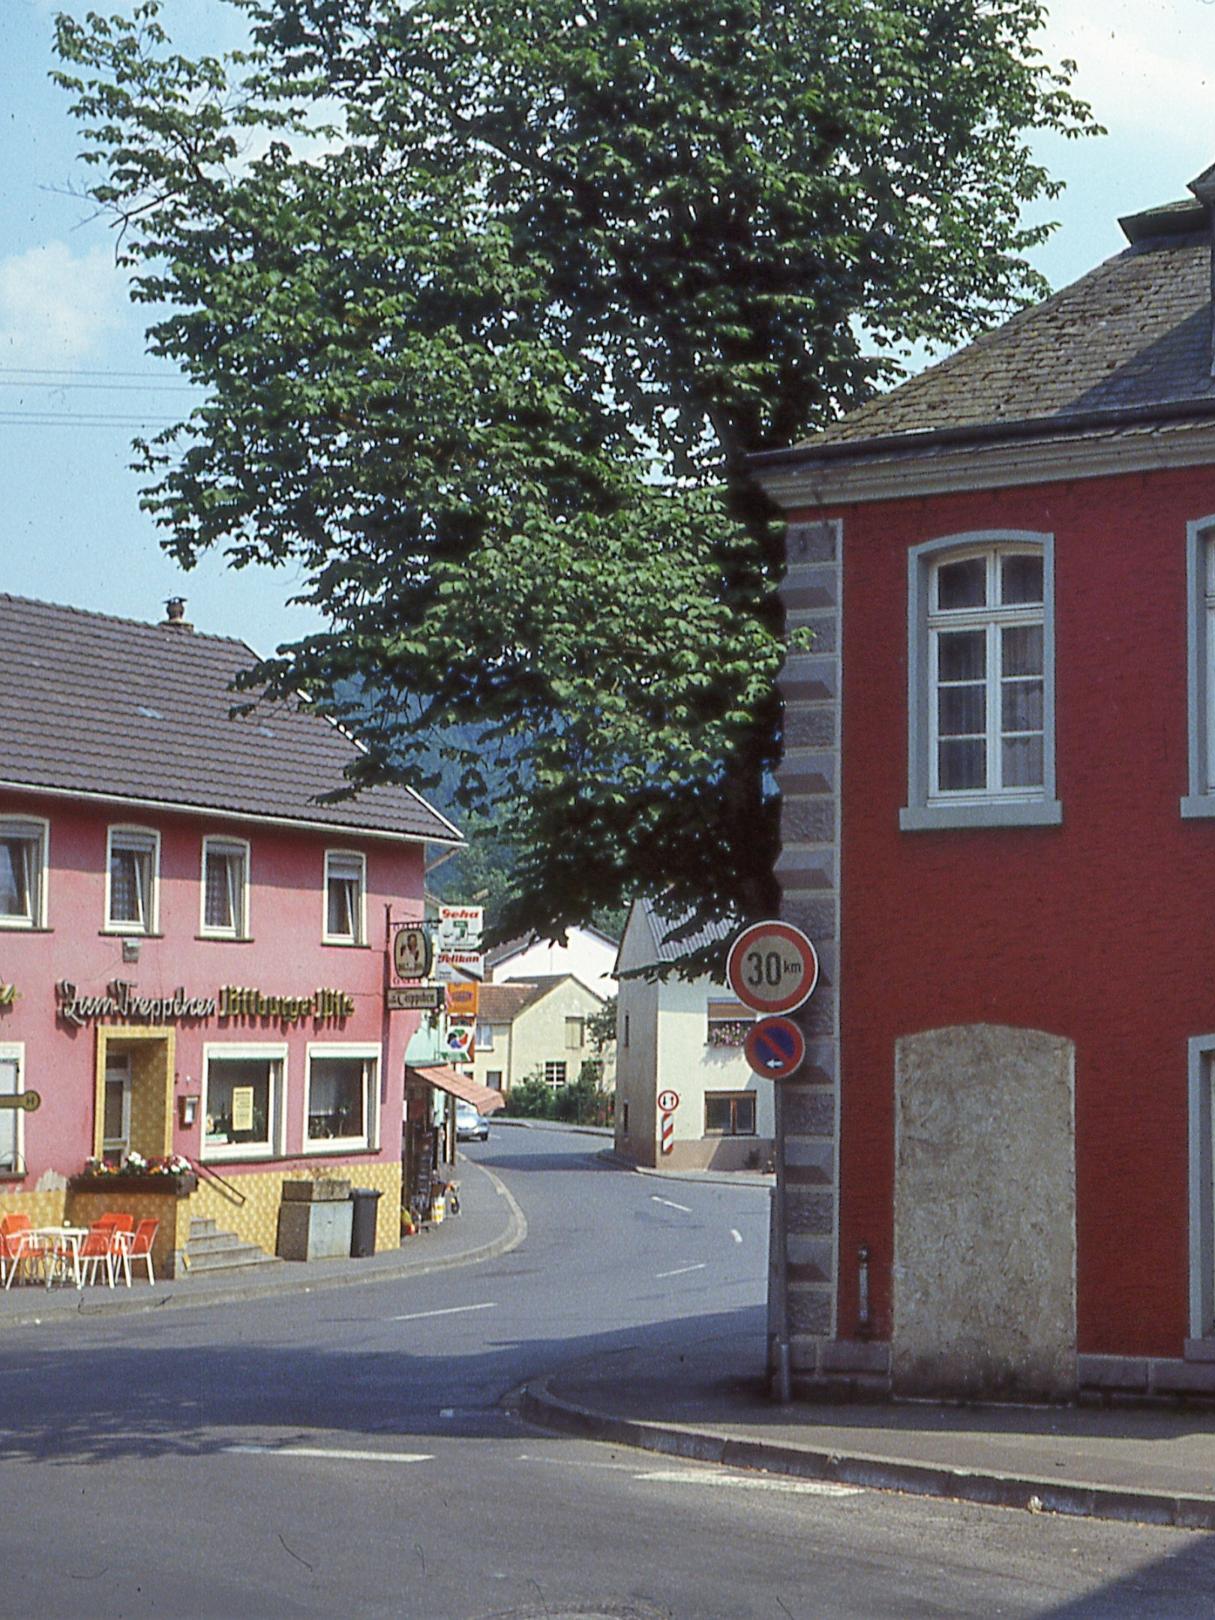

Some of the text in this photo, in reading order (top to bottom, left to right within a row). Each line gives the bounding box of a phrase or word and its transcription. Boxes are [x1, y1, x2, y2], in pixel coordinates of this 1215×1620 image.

[442, 909, 479, 918] Geha
[438, 953, 480, 963] Pelikan
[748, 951, 802, 986] 30 km
[57, 979, 216, 1025] Zum Treppchen
[219, 985, 354, 1022] Bitburger Pils
